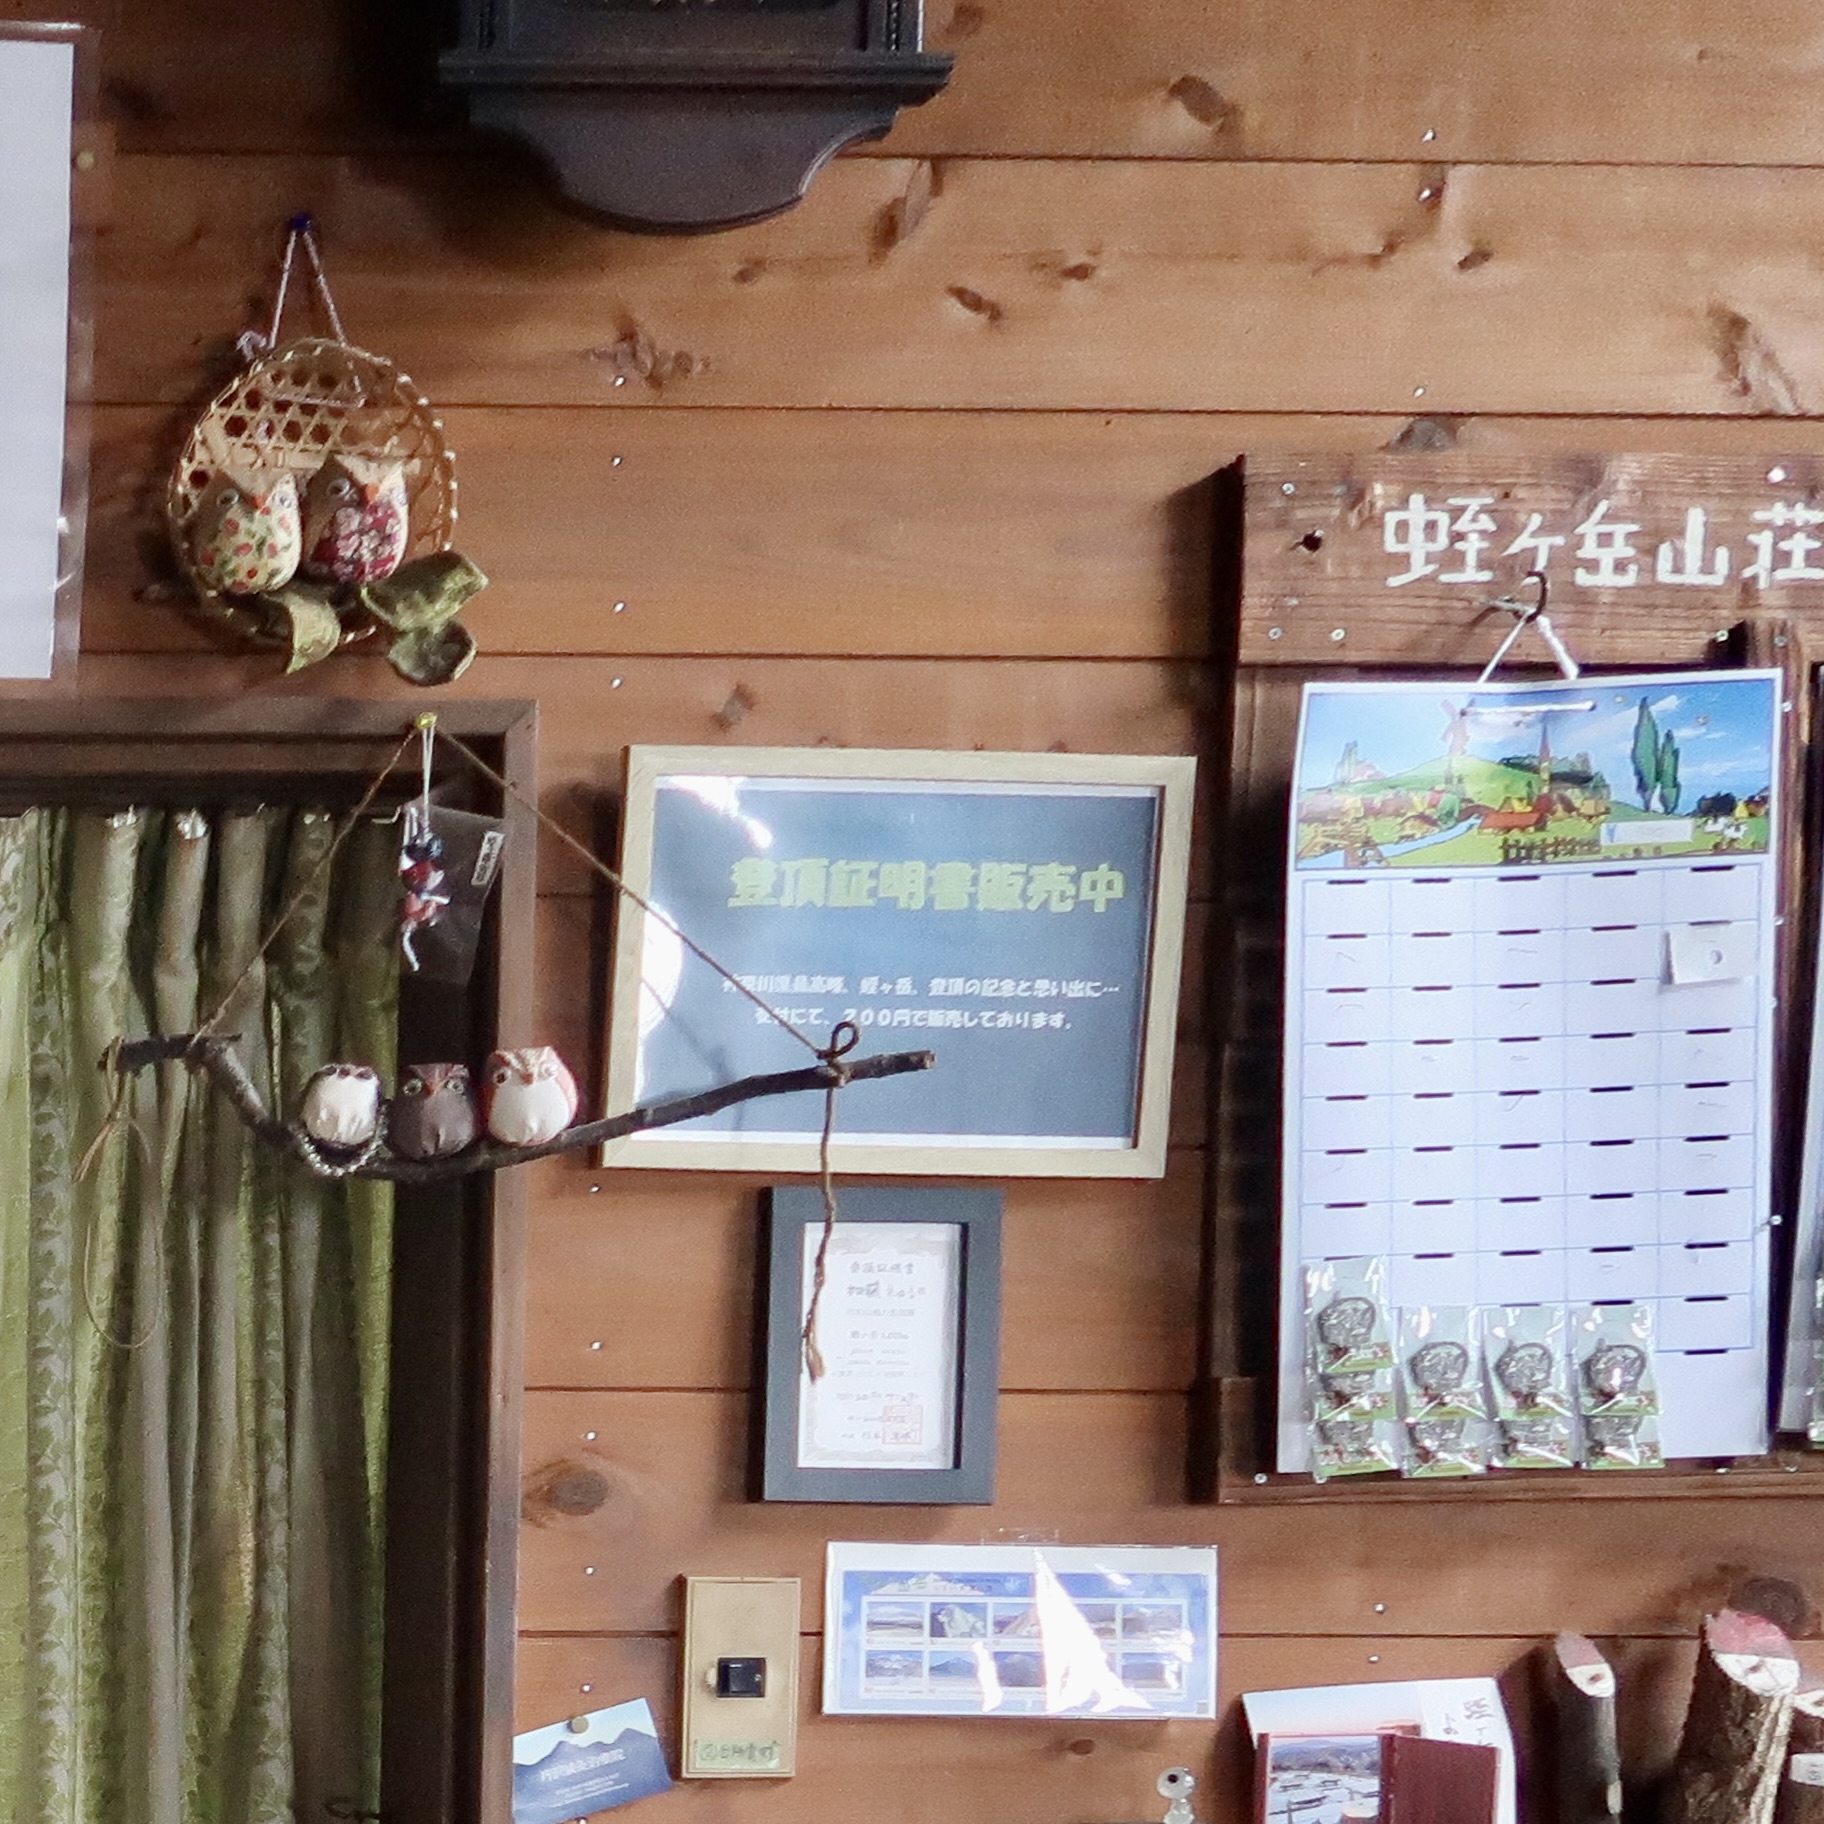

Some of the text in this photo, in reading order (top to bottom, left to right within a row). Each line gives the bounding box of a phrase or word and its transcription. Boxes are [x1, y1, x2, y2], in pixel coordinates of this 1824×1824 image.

[727, 857, 1125, 913] 登頂証明書販売中
